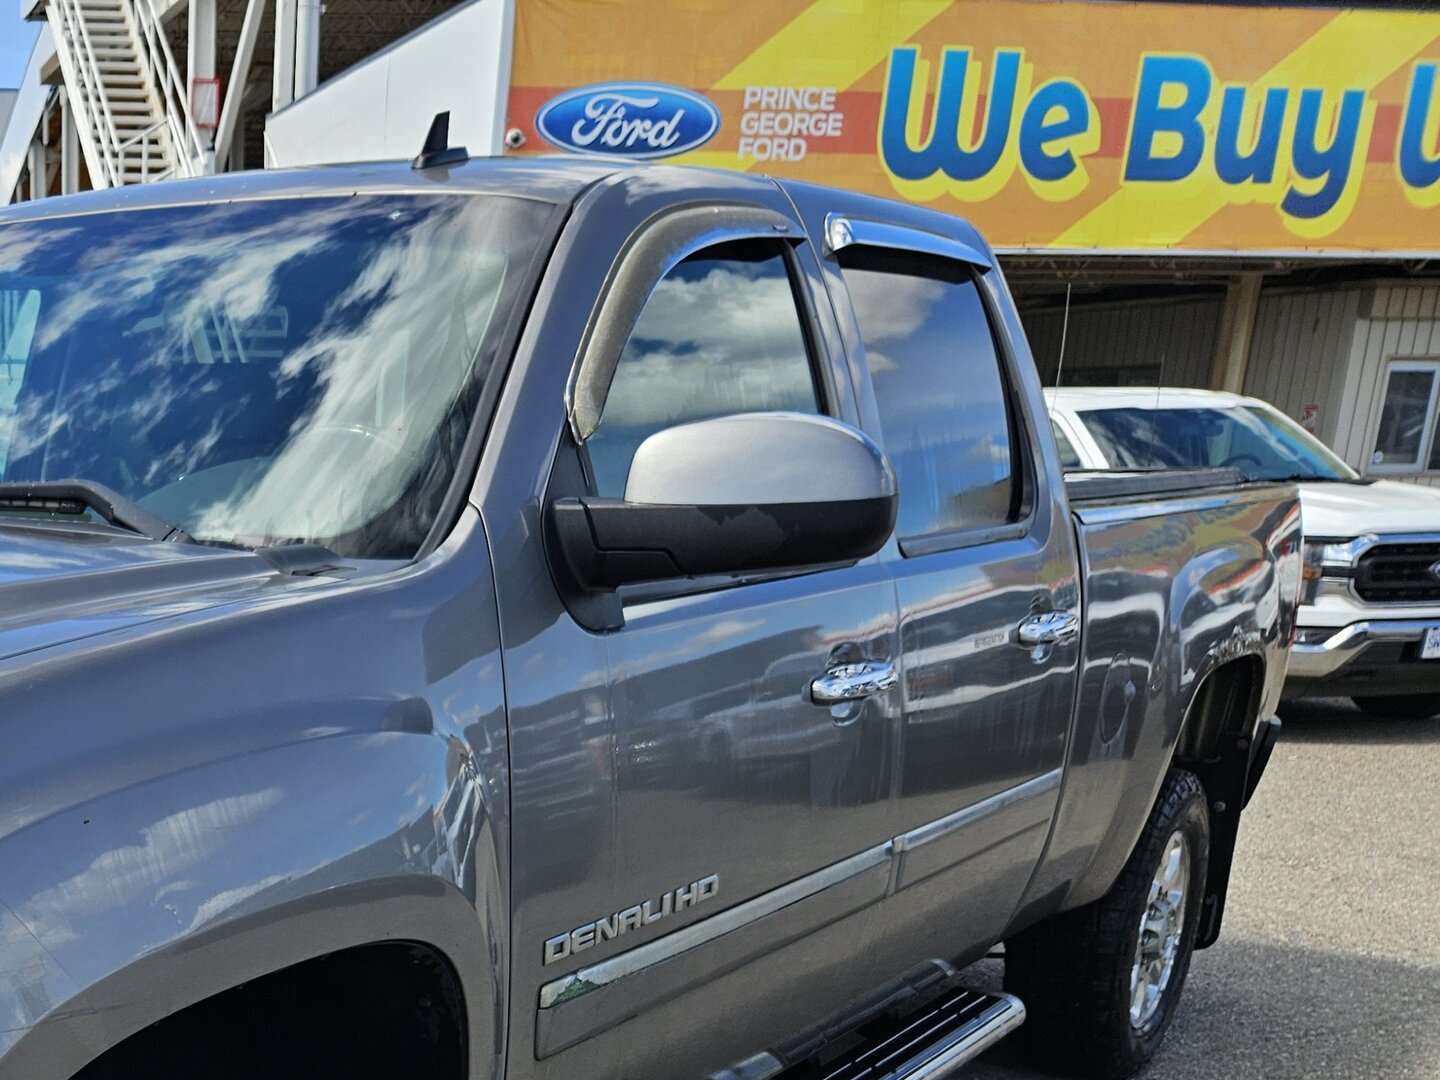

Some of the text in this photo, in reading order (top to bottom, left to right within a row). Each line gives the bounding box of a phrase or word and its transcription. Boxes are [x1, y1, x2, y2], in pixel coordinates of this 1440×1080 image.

[744, 86, 838, 111] PRINCE
[572, 94, 685, 147] Ford
[740, 112, 844, 137] GEORGE
[881, 48, 1089, 182] We
[1123, 55, 1366, 219] Buy
[737, 138, 807, 162] FORD
[544, 873, 719, 965] DENALI HD
